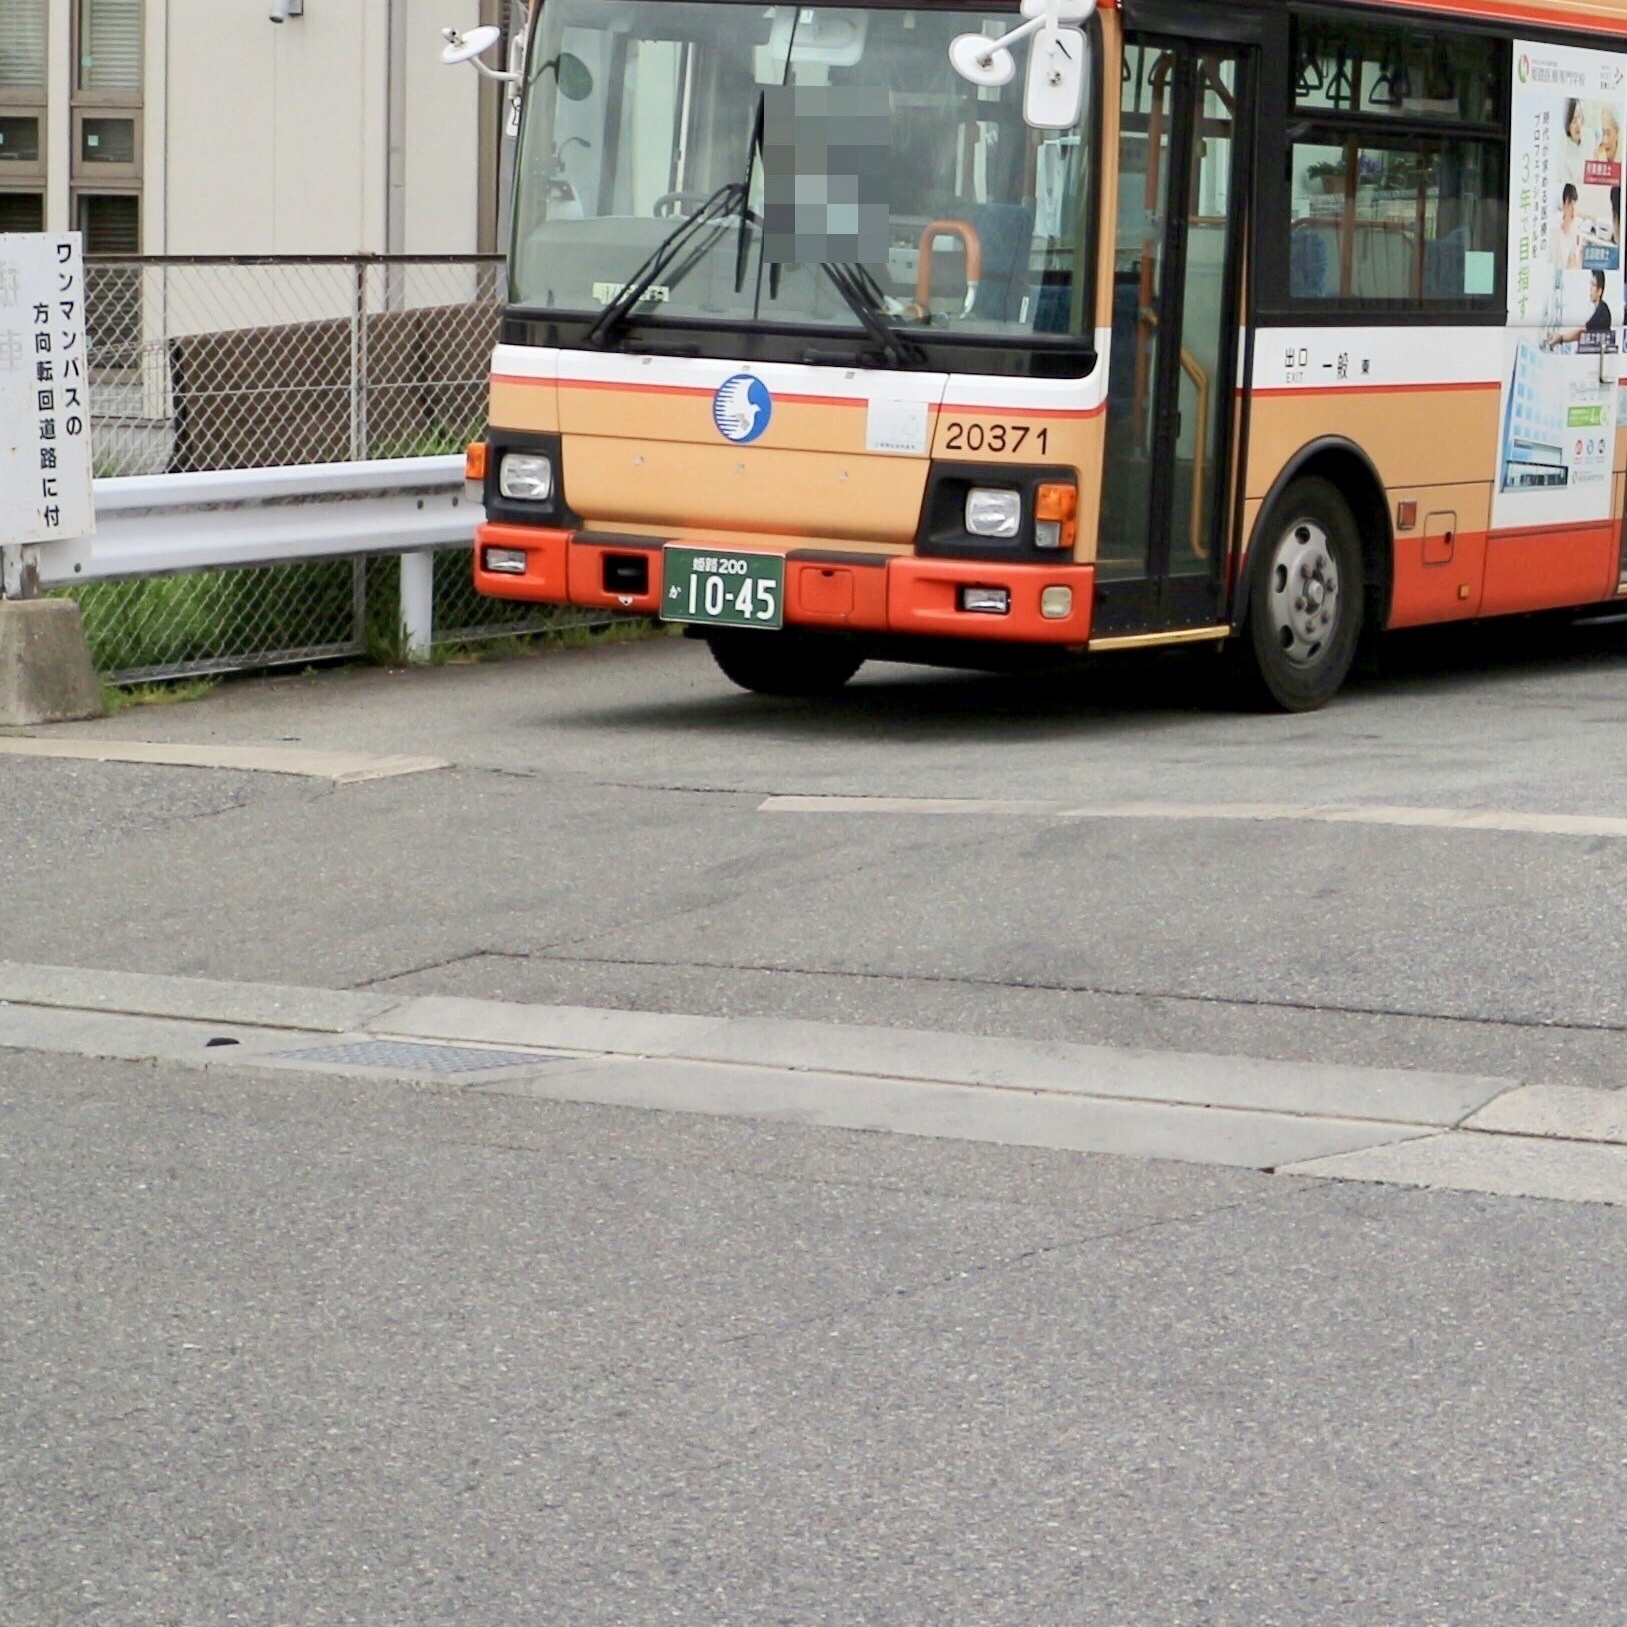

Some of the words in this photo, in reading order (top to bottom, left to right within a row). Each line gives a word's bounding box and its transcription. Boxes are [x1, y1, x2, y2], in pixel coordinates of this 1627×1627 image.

[56, 243, 82, 437] ワンマンバスの
[1285, 347, 1307, 367] 出口
[33, 302, 60, 527] 方向転回道路に付
[945, 422, 1048, 456] 20371
[669, 584, 682, 600] か
[688, 573, 776, 620] 10-45
